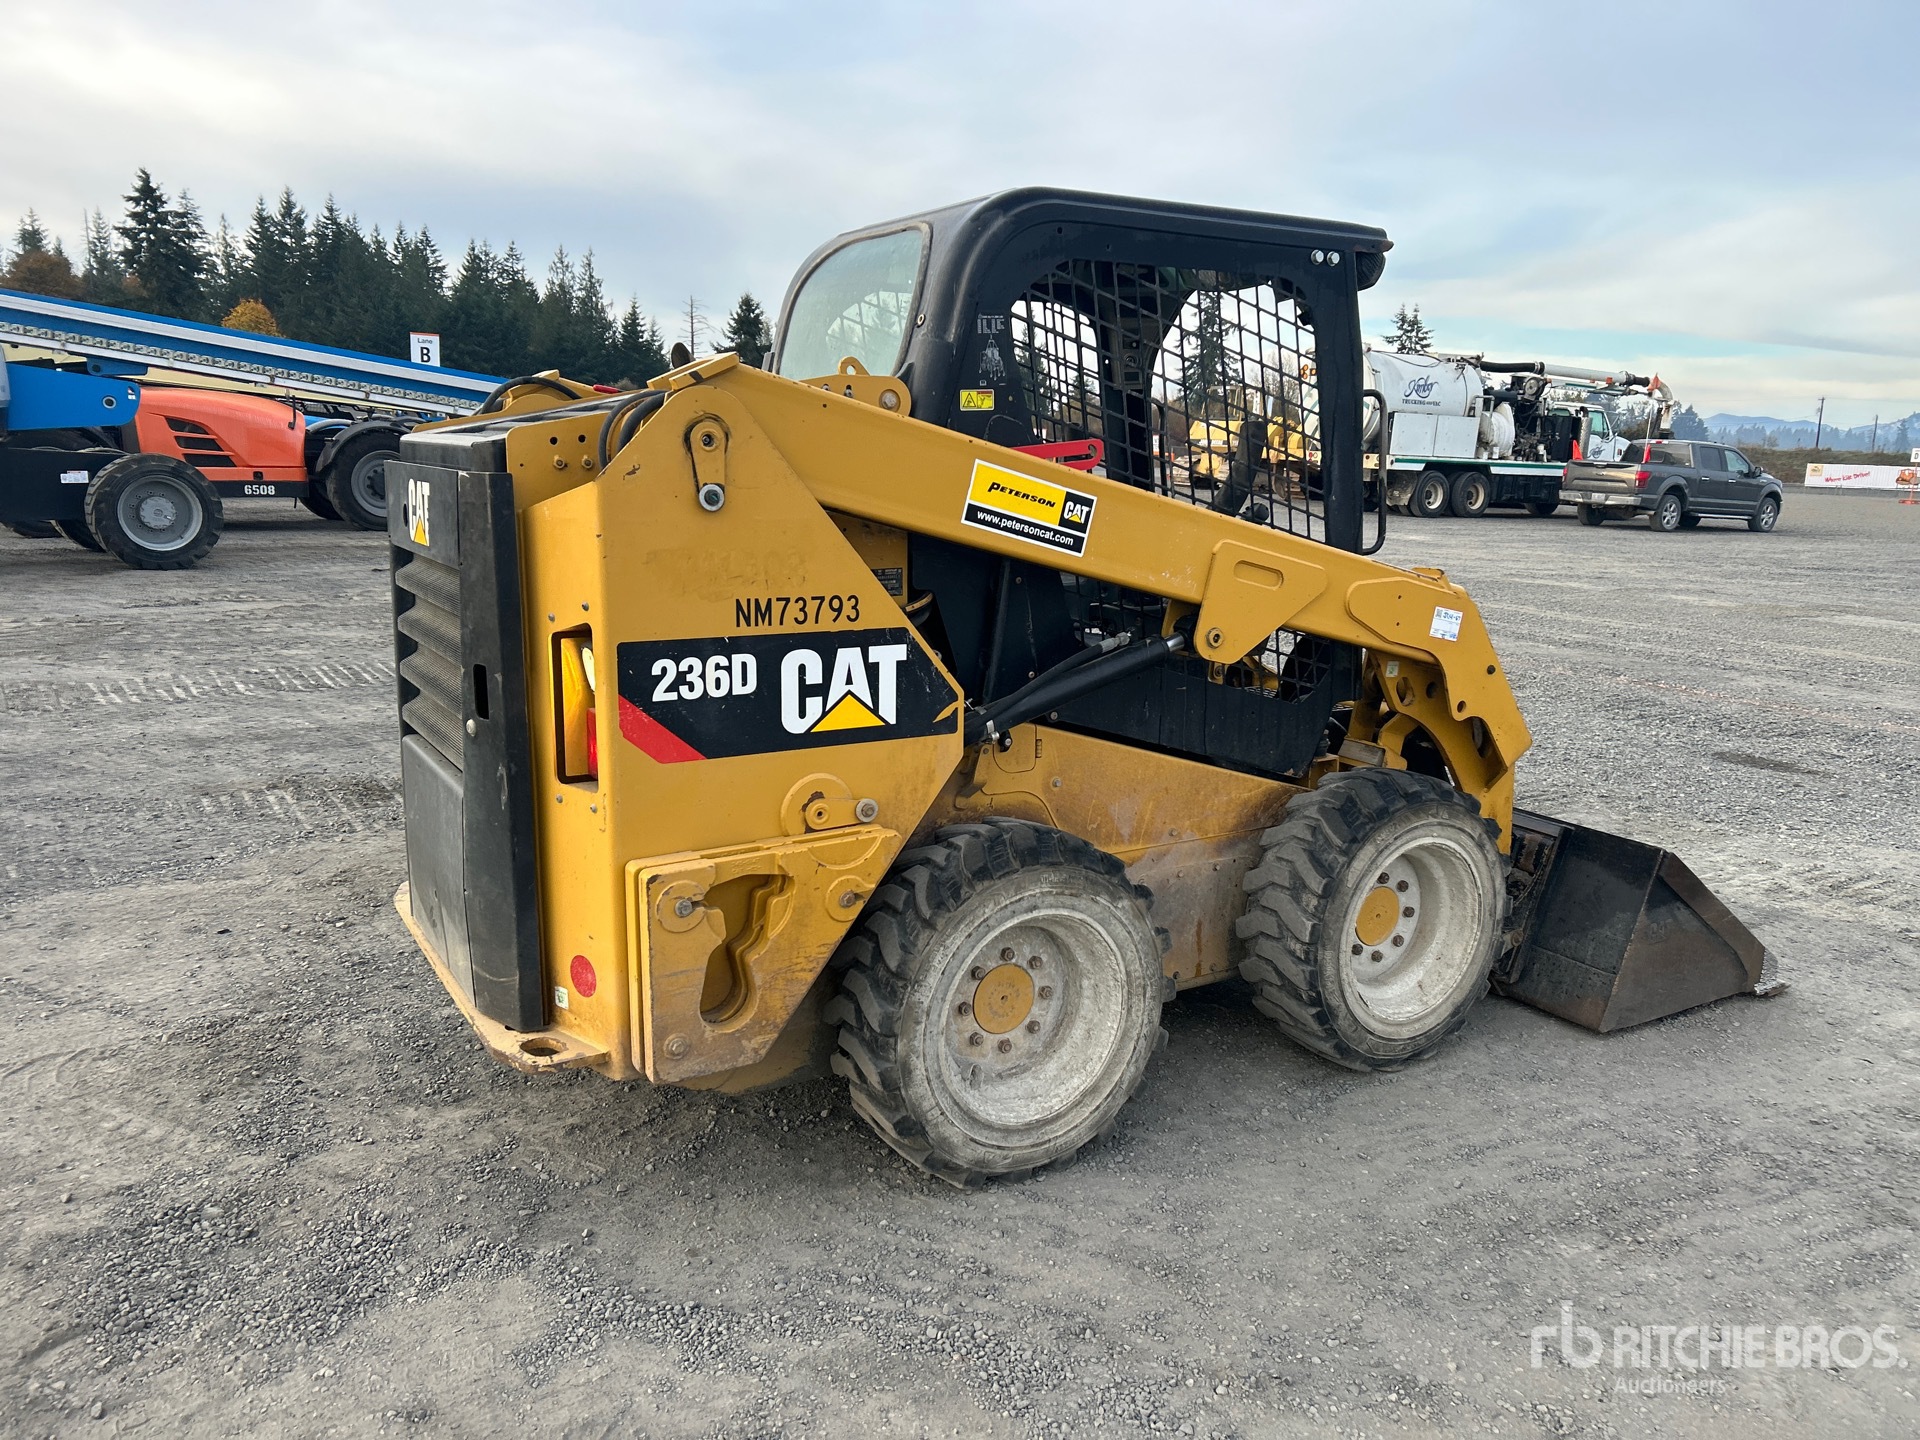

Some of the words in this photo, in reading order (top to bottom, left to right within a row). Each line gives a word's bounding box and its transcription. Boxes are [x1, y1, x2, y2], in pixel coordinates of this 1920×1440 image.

[420, 346, 431, 363] B
[244, 484, 276, 495] 6508
[987, 481, 1056, 508] PETERSON
[408, 478, 430, 547] CAT
[1063, 501, 1091, 524] CAT
[977, 510, 1074, 546] www.petersoncat.com
[735, 594, 861, 628] NM73793
[651, 653, 758, 702] 236D
[780, 643, 908, 735] CAT
